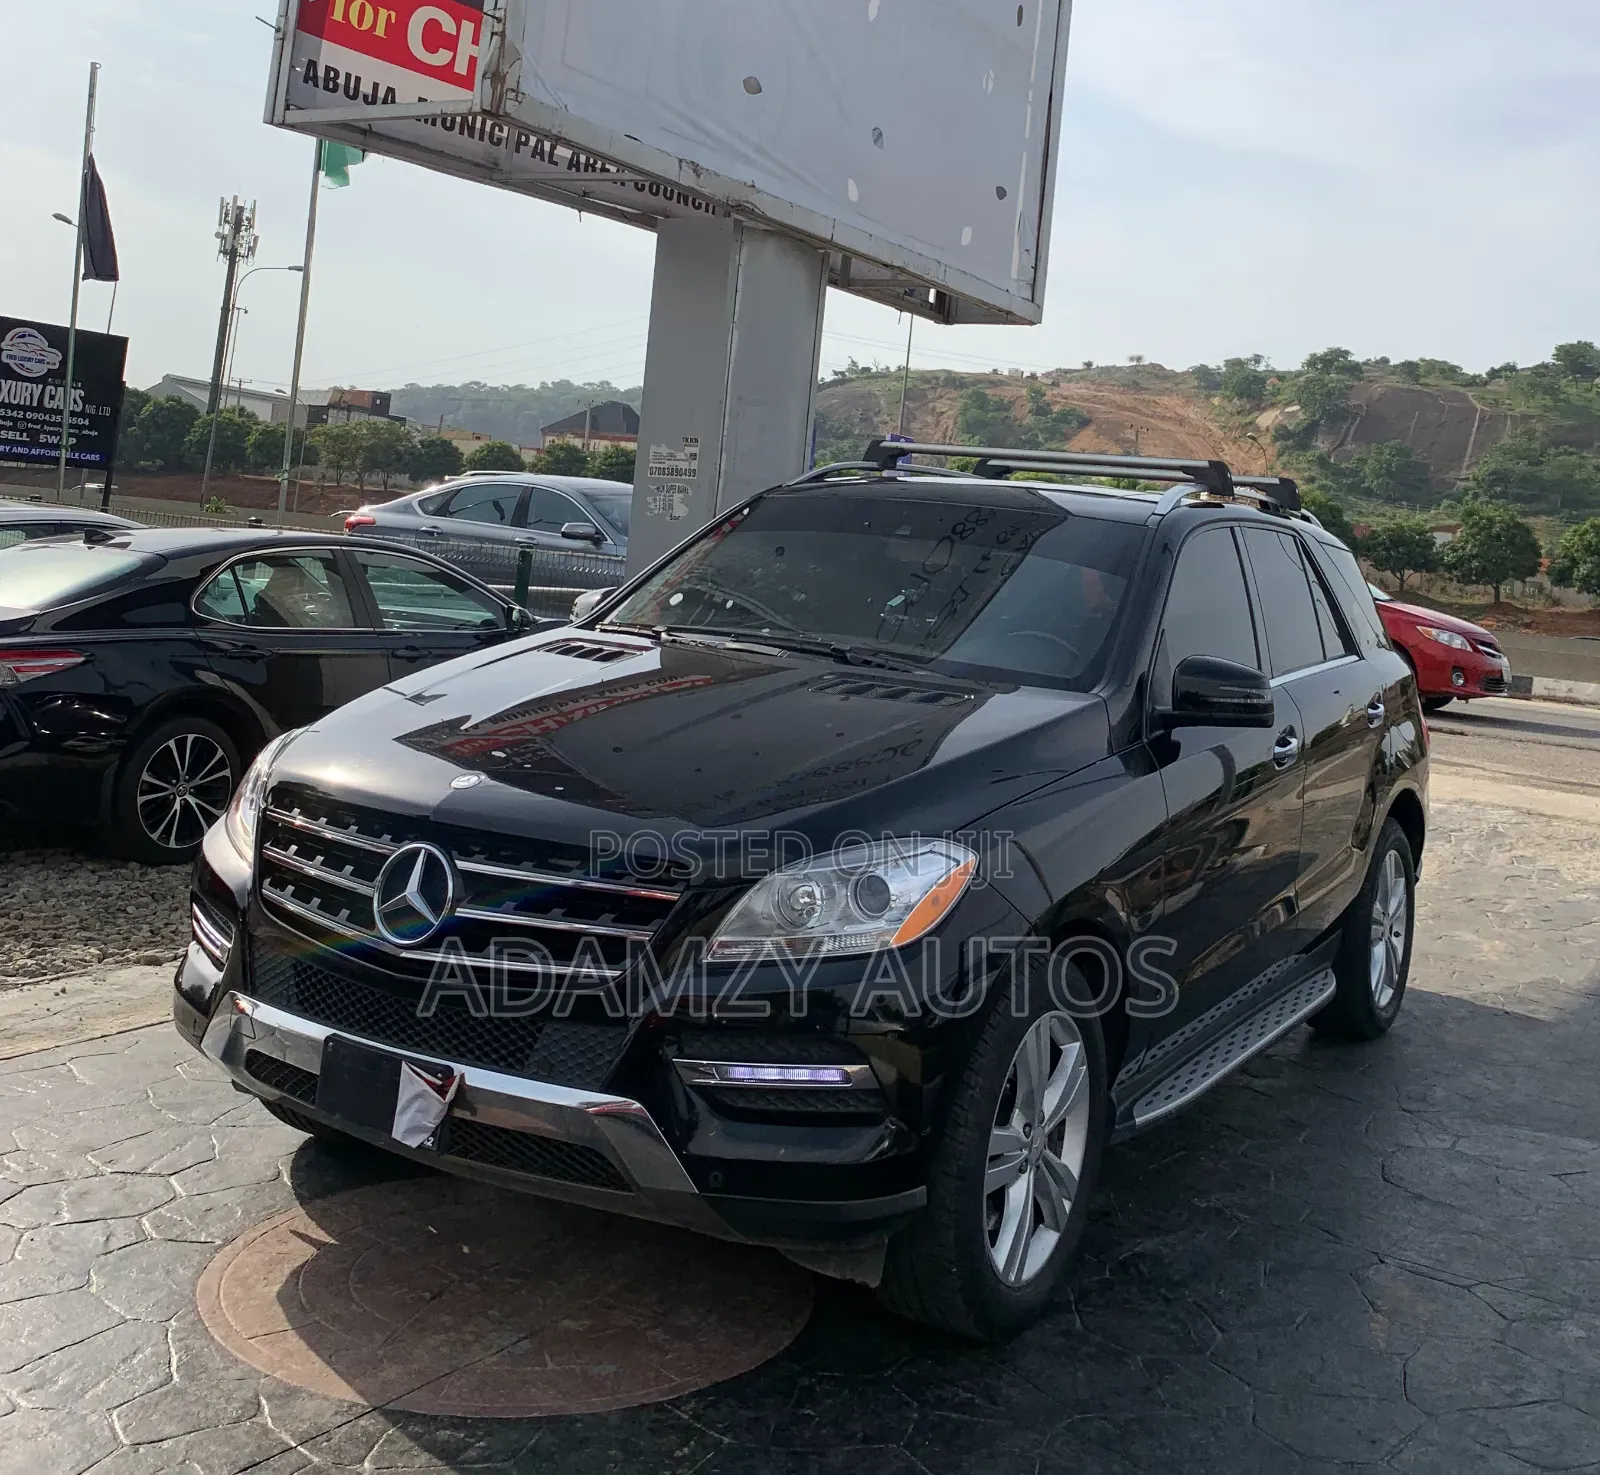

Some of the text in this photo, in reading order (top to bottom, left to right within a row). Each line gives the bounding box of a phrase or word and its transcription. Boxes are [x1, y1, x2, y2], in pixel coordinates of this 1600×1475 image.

[303, 59, 396, 106] ABUJA
[99, 406, 111, 416] LTD
[39, 434, 77, 445] SWP
[12, 446, 29, 454] AND
[30, 448, 80, 460] AFFORDBLE
[80, 453, 100, 461] CARS
